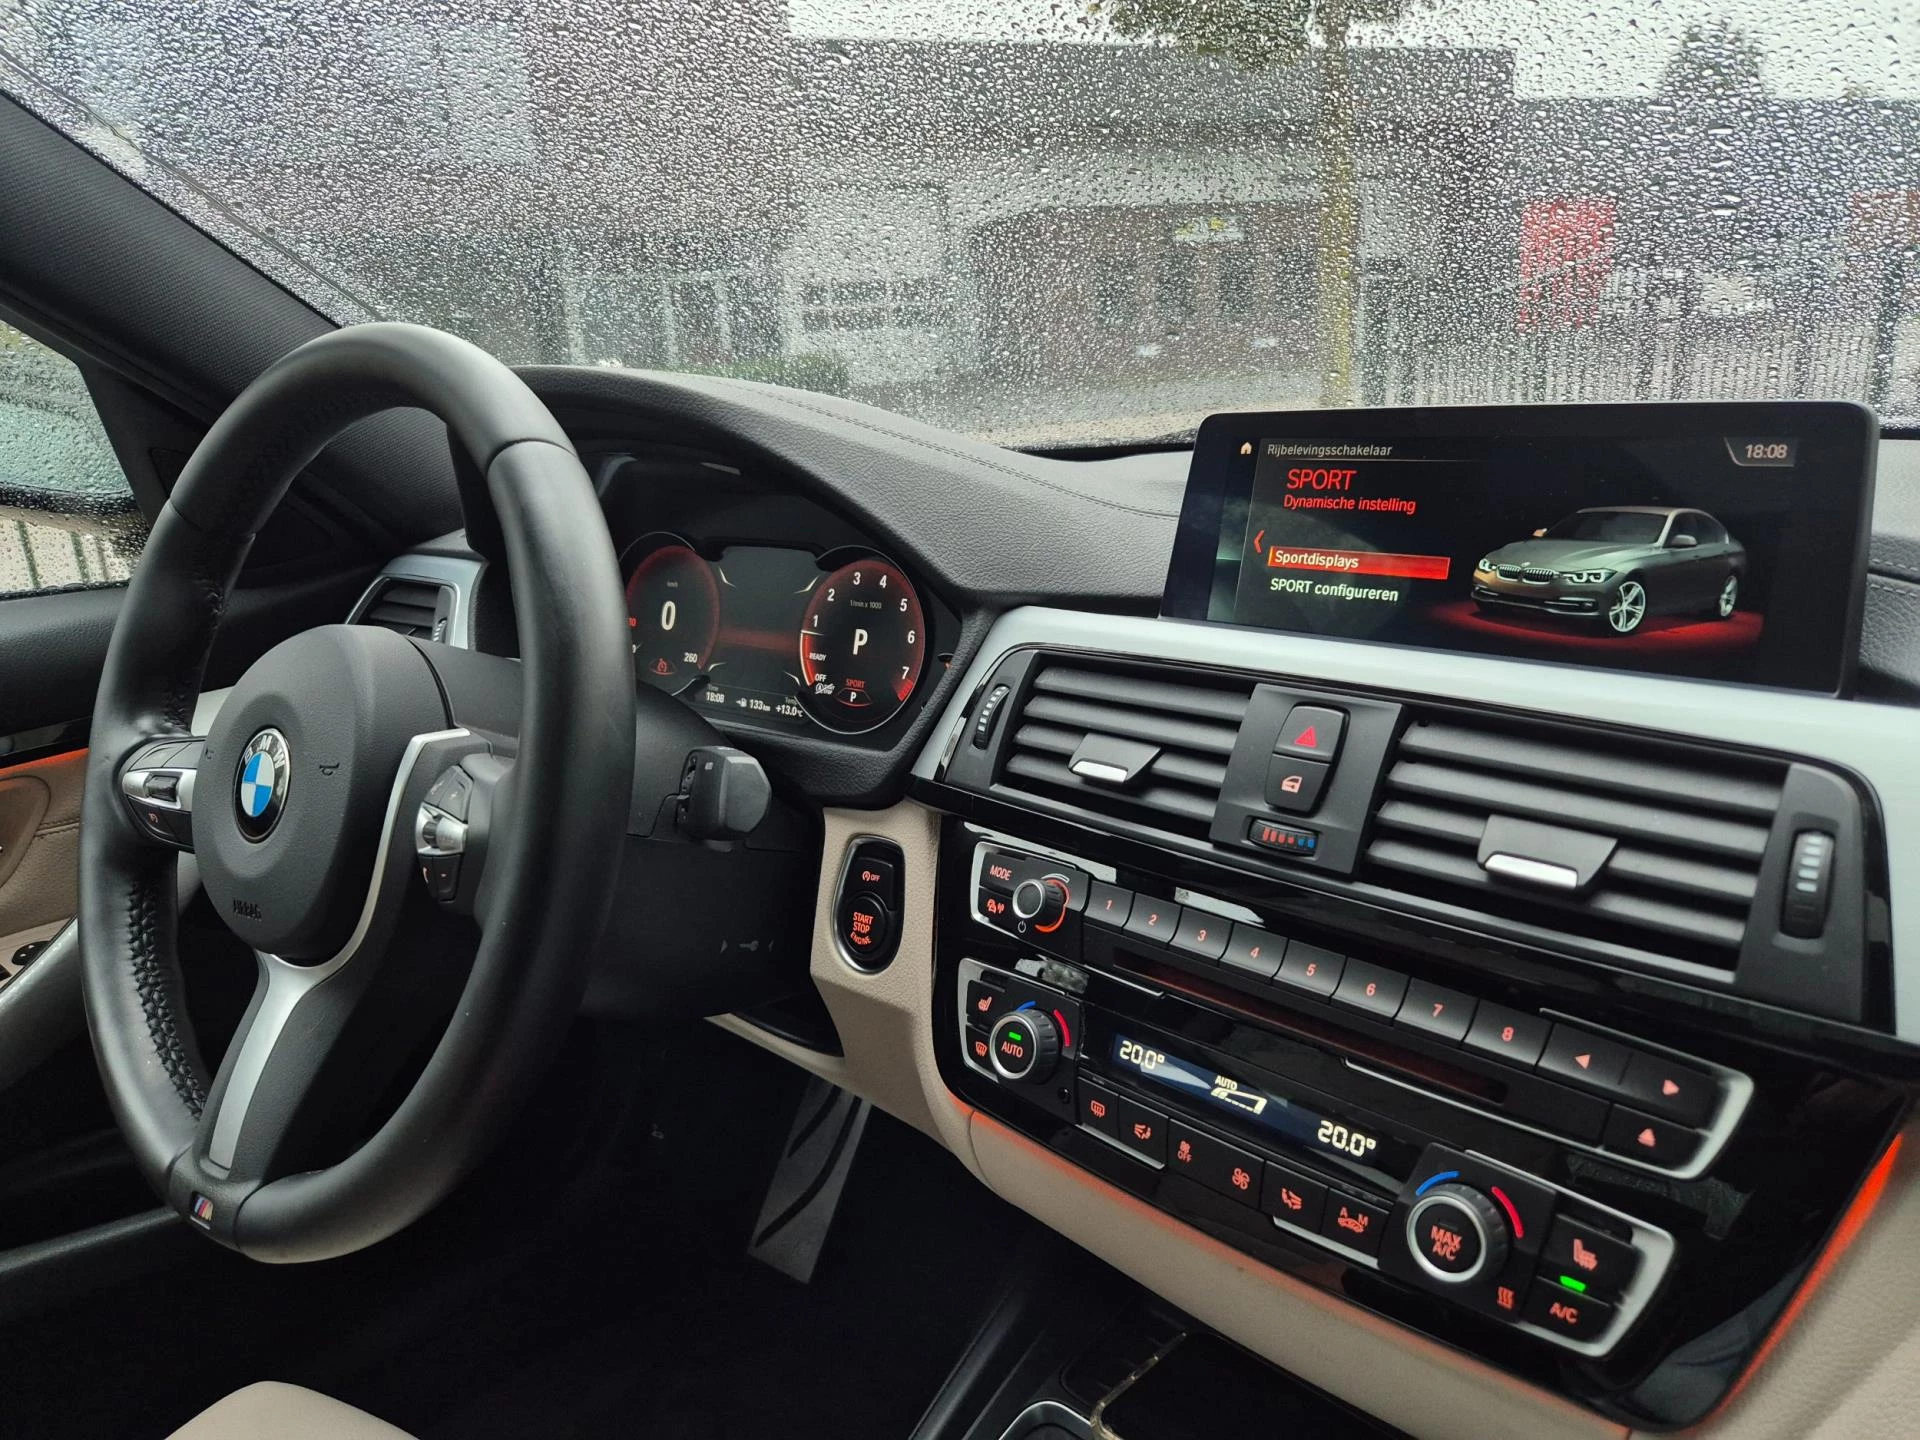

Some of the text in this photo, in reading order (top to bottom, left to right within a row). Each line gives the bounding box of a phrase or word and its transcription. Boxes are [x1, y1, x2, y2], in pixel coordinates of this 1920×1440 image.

[1267, 443, 1393, 458] Rijbelevingsschakelaar
[1745, 443, 1788, 459] 18:08
[1286, 468, 1357, 490] SPORT
[1283, 493, 1417, 515] Dynamische instelling
[1274, 549, 1359, 571] Sportdisplays
[853, 571, 861, 585] 3
[879, 574, 888, 588] 4
[827, 588, 835, 602] 2
[1270, 577, 1399, 601] SPORT configureren
[899, 598, 908, 612] 5
[661, 600, 676, 631] 0
[813, 614, 819, 628] 1
[852, 628, 868, 655] P
[907, 630, 916, 644] 6
[684, 652, 698, 663] 260
[815, 673, 827, 683] OFF
[902, 666, 910, 680] 7
[846, 678, 865, 689] SPORT
[850, 691, 857, 703] P
[244, 734, 286, 769] BMW
[989, 864, 1012, 881] MODE
[1105, 899, 1113, 911] 1
[852, 911, 874, 925] START
[1148, 913, 1158, 926] 2
[853, 921, 870, 934] STOP
[850, 931, 872, 945] ENGINE
[1197, 929, 1207, 942] 3
[1250, 947, 1260, 959] 4
[1306, 963, 1316, 977] 5
[1366, 983, 1376, 996] 6
[1434, 1003, 1444, 1016] 7
[1503, 1026, 1514, 1041] 8
[1001, 1041, 1024, 1058] AUTO
[1215, 1075, 1238, 1091] AUTO
[1178, 1150, 1192, 1162] OFF
[1431, 1225, 1462, 1250] MAX
[1433, 1241, 1457, 1261] A/C
[1550, 1302, 1578, 1324] A/C
